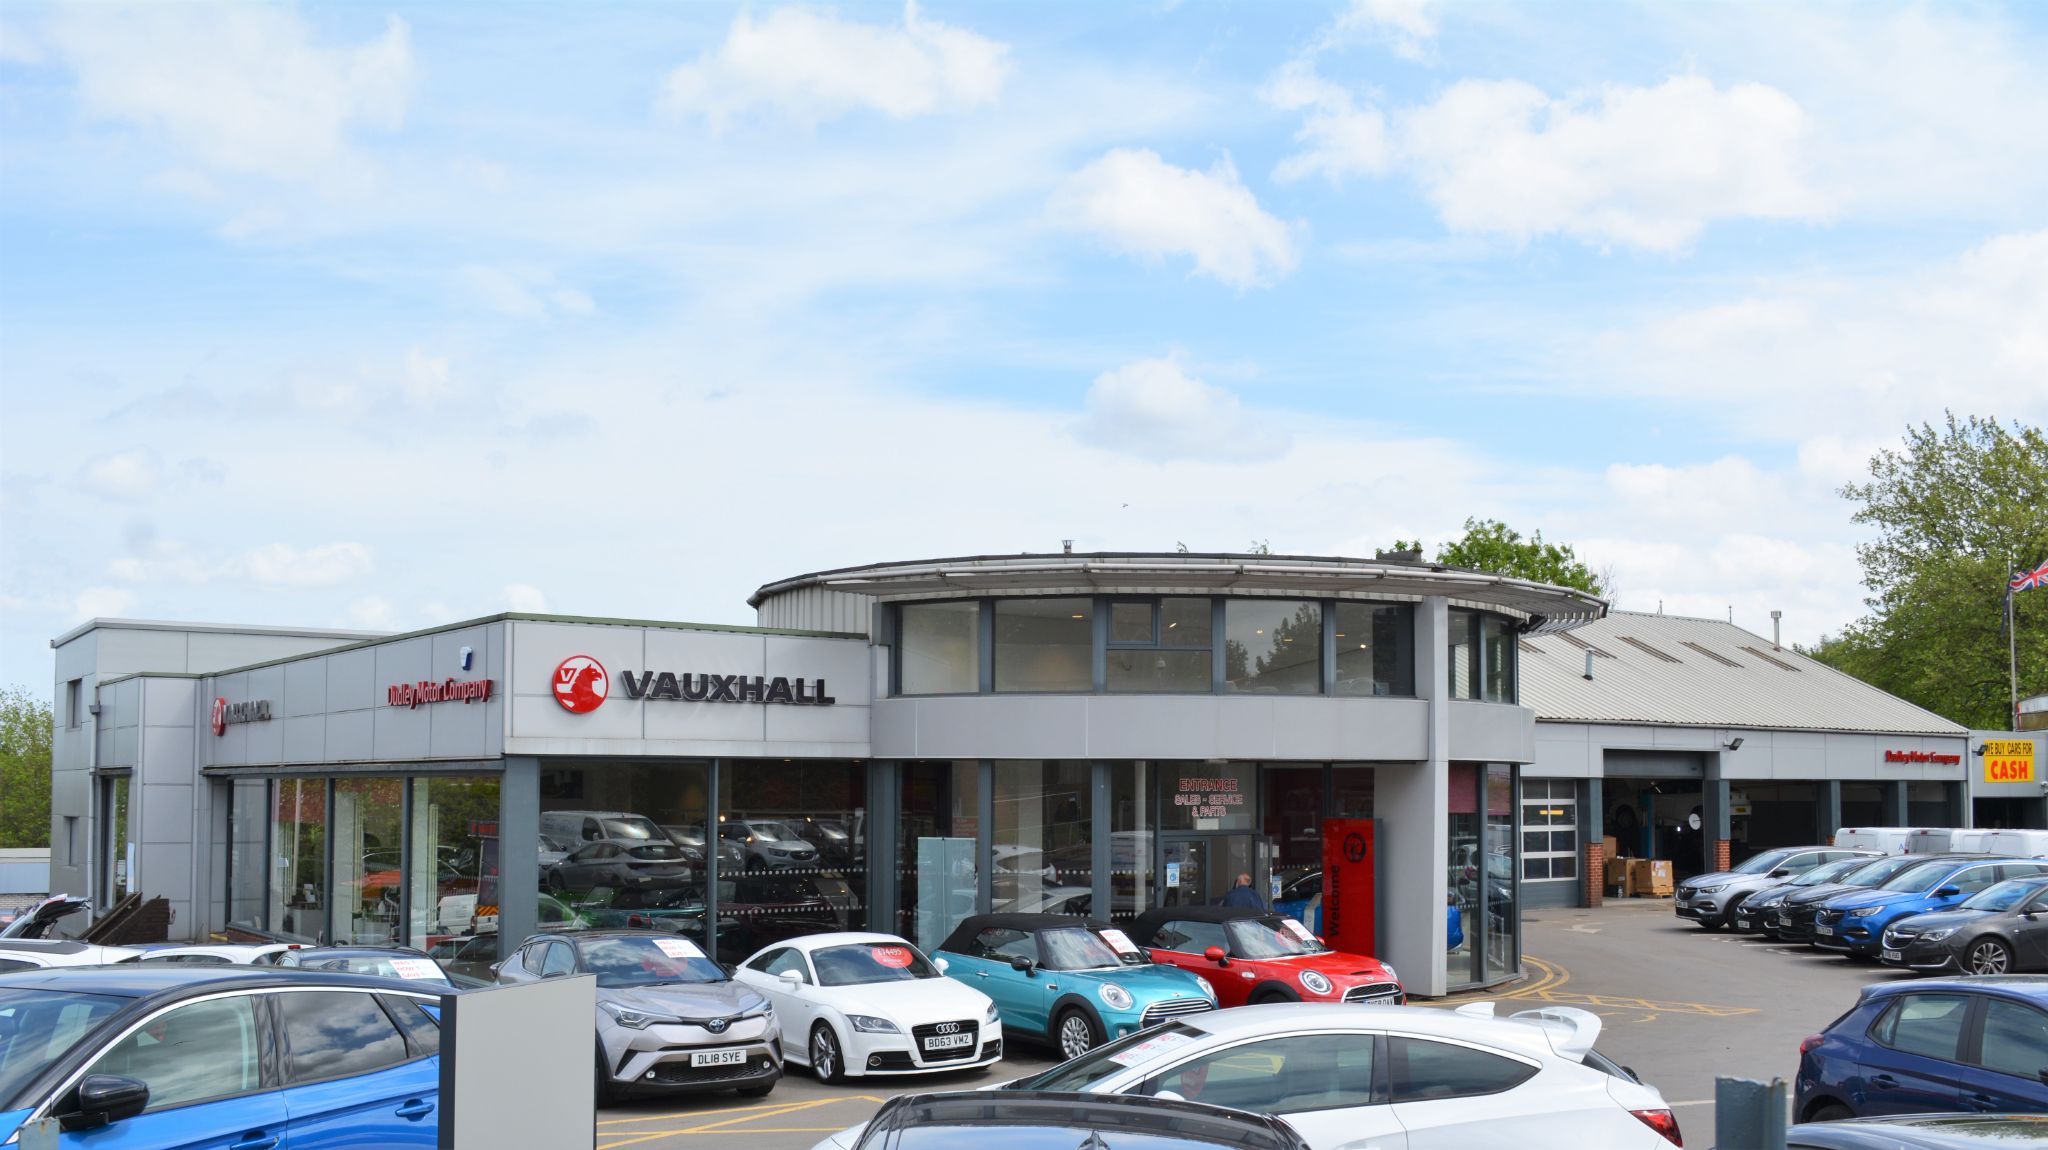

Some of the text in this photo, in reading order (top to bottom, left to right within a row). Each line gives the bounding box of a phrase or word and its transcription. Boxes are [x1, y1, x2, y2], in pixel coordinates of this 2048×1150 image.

[387, 677, 492, 709] Dudley Motor Company
[621, 670, 836, 704] VAUXHALL
[1995, 742, 2006, 754] BUY
[2007, 742, 2022, 754] CARS
[2022, 742, 2033, 754] FOR
[1990, 760, 2028, 780] CASH
[1179, 778, 1238, 792] ENTRANCE
[1174, 794, 1201, 806] SALES
[1208, 794, 1243, 805] SERVICE
[1200, 805, 1227, 817] PARTS
[1329, 864, 1340, 937] Welcome
[928, 1034, 970, 1048] BD63 VMZ
[698, 1051, 741, 1065] DL18 SYE
